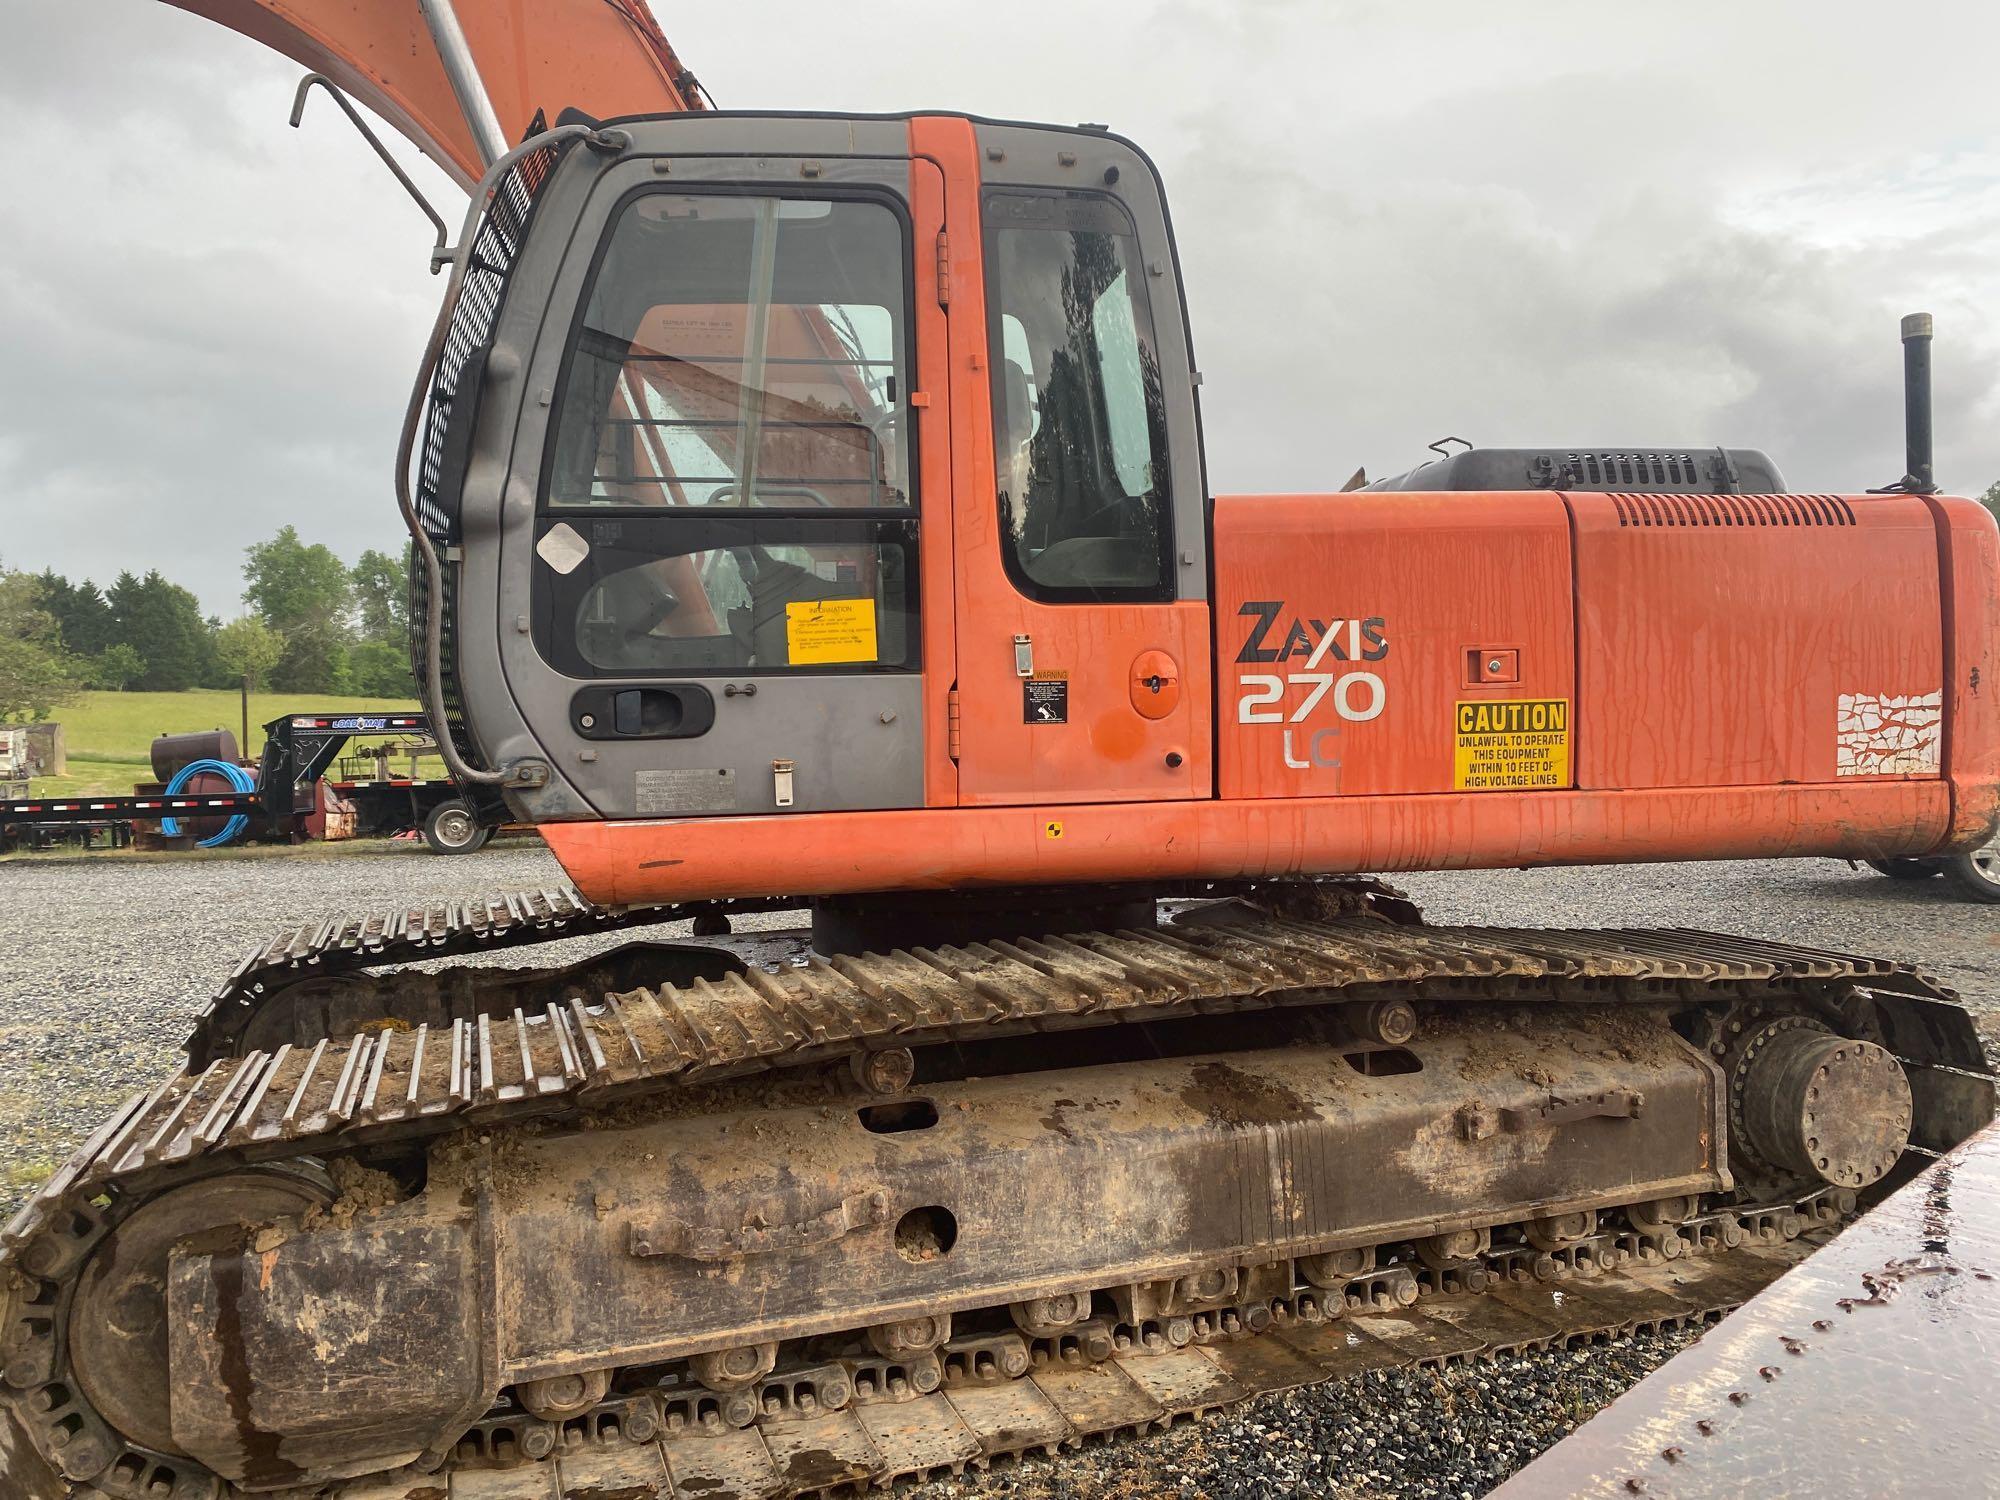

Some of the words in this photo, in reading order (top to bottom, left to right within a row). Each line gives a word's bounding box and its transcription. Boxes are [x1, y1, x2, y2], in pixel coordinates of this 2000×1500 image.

[809, 606, 852, 614] INFORMATION
[1235, 601, 1389, 670] ZAXIS
[1036, 671, 1067, 680] WARNING
[1239, 672, 1386, 724] 270
[332, 719, 358, 728] LOAD
[364, 719, 386, 728] MAX
[1460, 704, 1564, 732] CAUTION
[1459, 736, 1509, 748] UNLAWFUL
[1511, 735, 1522, 746] TO
[1524, 734, 1565, 746] OPERATE
[1284, 728, 1341, 769] LC
[1473, 750, 1494, 760] THIS
[1496, 748, 1550, 760] EQUIPMENT
[1469, 763, 1503, 774] WITHIN
[1505, 762, 1516, 773] 10
[1518, 761, 1540, 773] FEET
[1542, 760, 1554, 772] OF
[1464, 777, 1487, 787] HIGH
[1489, 775, 1529, 787] VOLTAGE
[1531, 774, 1558, 785] LINES
